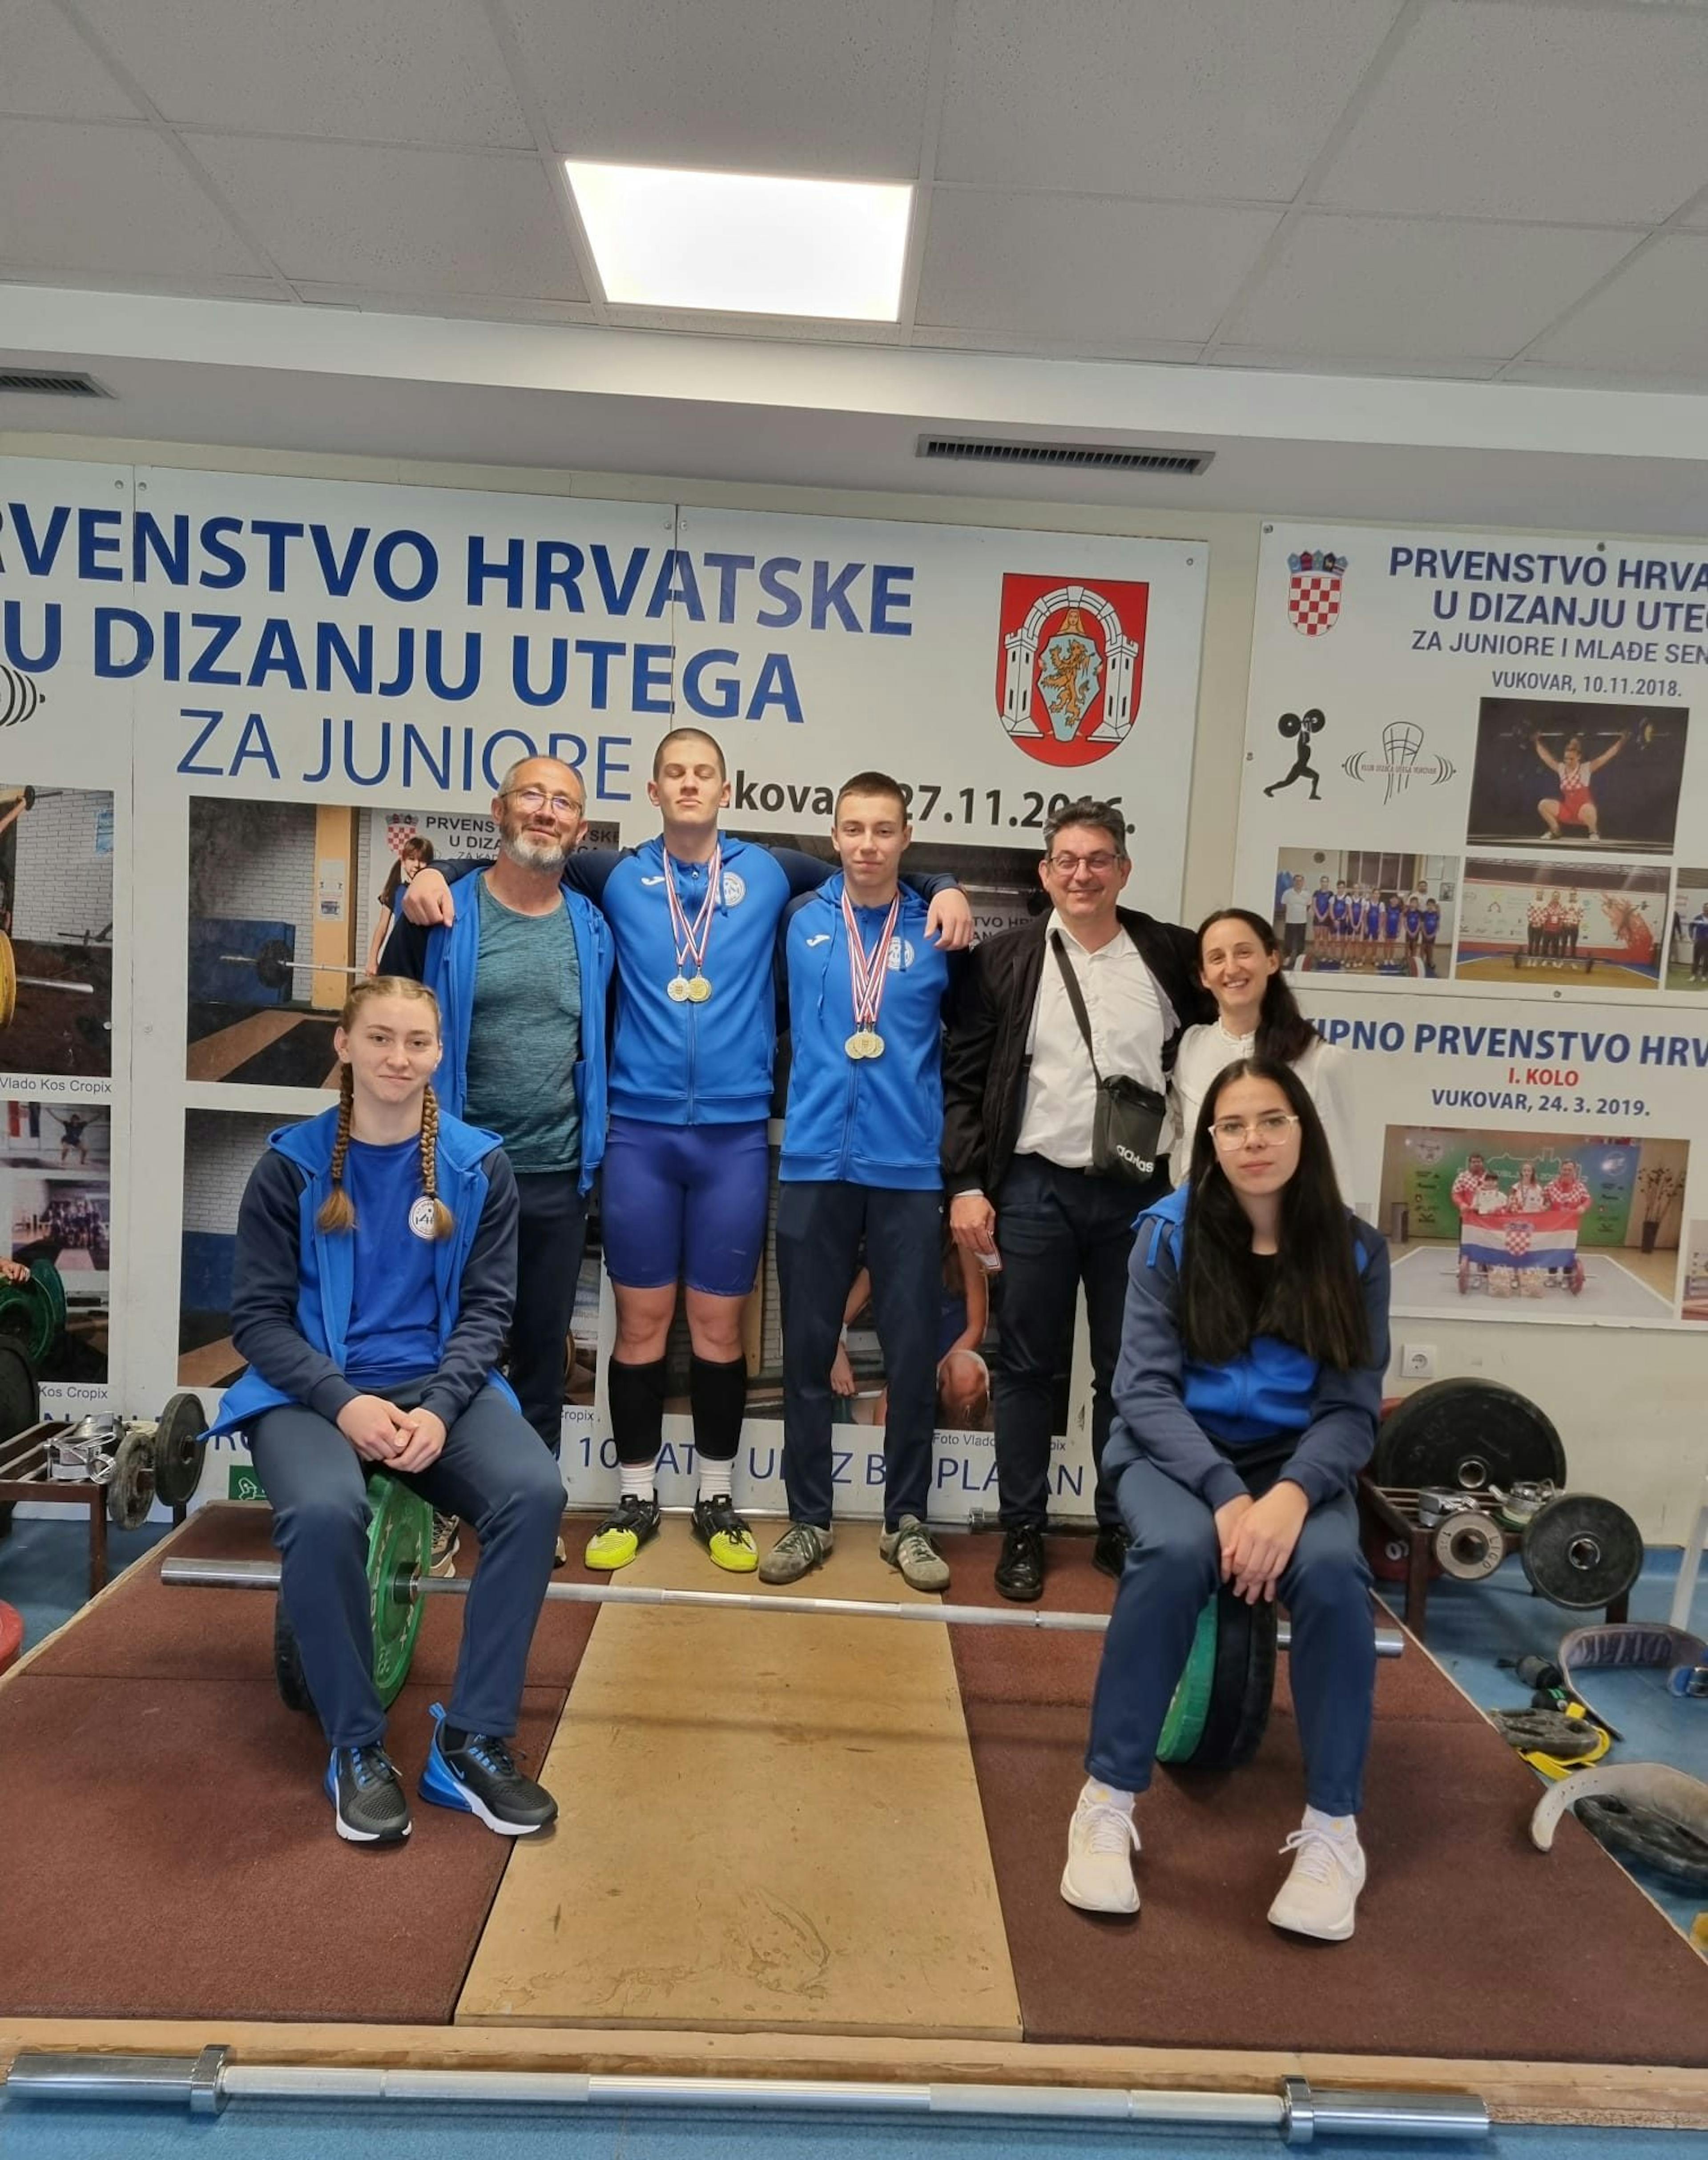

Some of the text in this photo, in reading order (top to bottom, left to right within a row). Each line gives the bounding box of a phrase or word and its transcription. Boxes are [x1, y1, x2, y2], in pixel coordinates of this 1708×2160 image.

[0, 503, 914, 636] VENSTVO HRVATSKE
[1390, 547, 1607, 587] PRVENSTVO
[1434, 590, 1708, 633] U DIZANJU UTE
[4, 600, 804, 723] U DIZANJU UTEGA
[1412, 630, 1442, 651] ZA
[1449, 632, 1555, 656] JUNIORE
[1562, 638, 1567, 657] I
[1575, 639, 1658, 662] MLAĐE
[1492, 670, 1682, 697] VUKOVAR, 10.11.2018.
[177, 708, 281, 780] ZA
[735, 770, 834, 815] kova
[1414, 1024, 1630, 1063] PRVENSTVO
[0, 1077, 112, 1094] Vlado Kos Cropix
[1508, 1068, 1579, 1086] I. KOLO
[1432, 1089, 1650, 1116] VUKOVAR, 24. 3. 2019.
[67, 1387, 108, 1401] Cropix
[579, 1437, 620, 1469] 10
